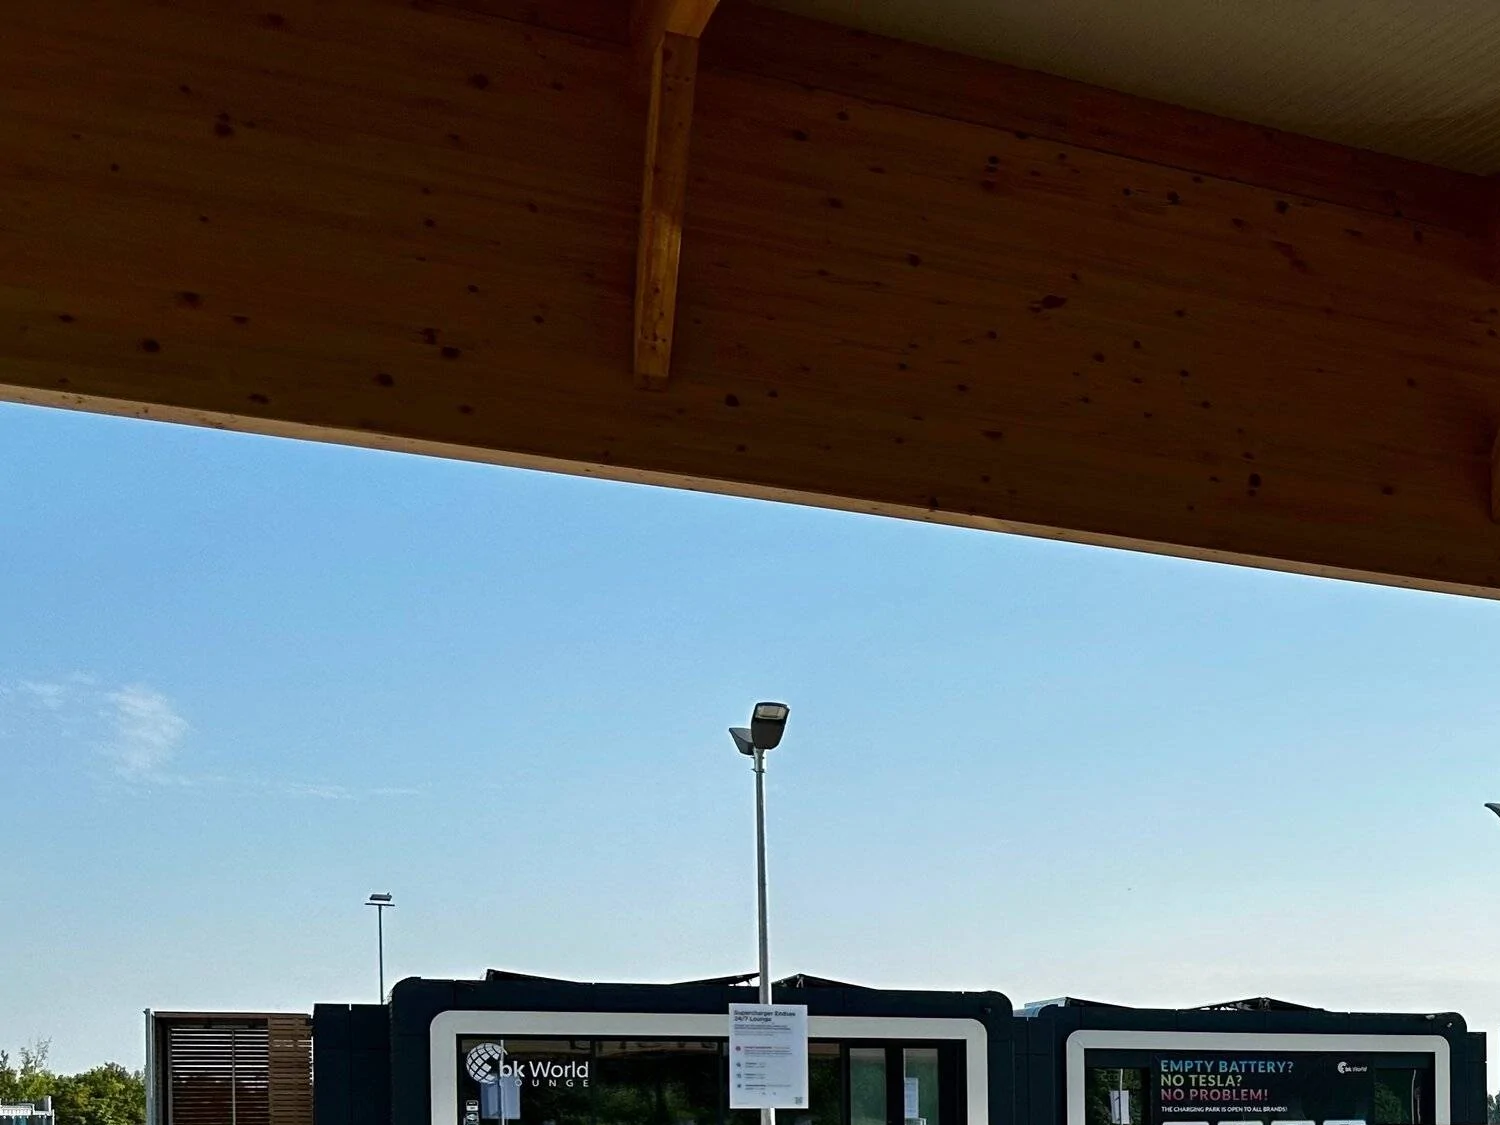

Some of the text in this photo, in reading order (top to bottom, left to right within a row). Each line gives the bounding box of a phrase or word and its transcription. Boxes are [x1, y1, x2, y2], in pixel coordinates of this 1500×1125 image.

[500, 1061, 589, 1078] bk World
[1160, 1060, 1294, 1073] EMPTY BATTERY?
[500, 1079, 589, 1088] OUNGE
[1160, 1074, 1243, 1087] NO TESLA?
[1160, 1088, 1269, 1101] NO PROBLEM!
